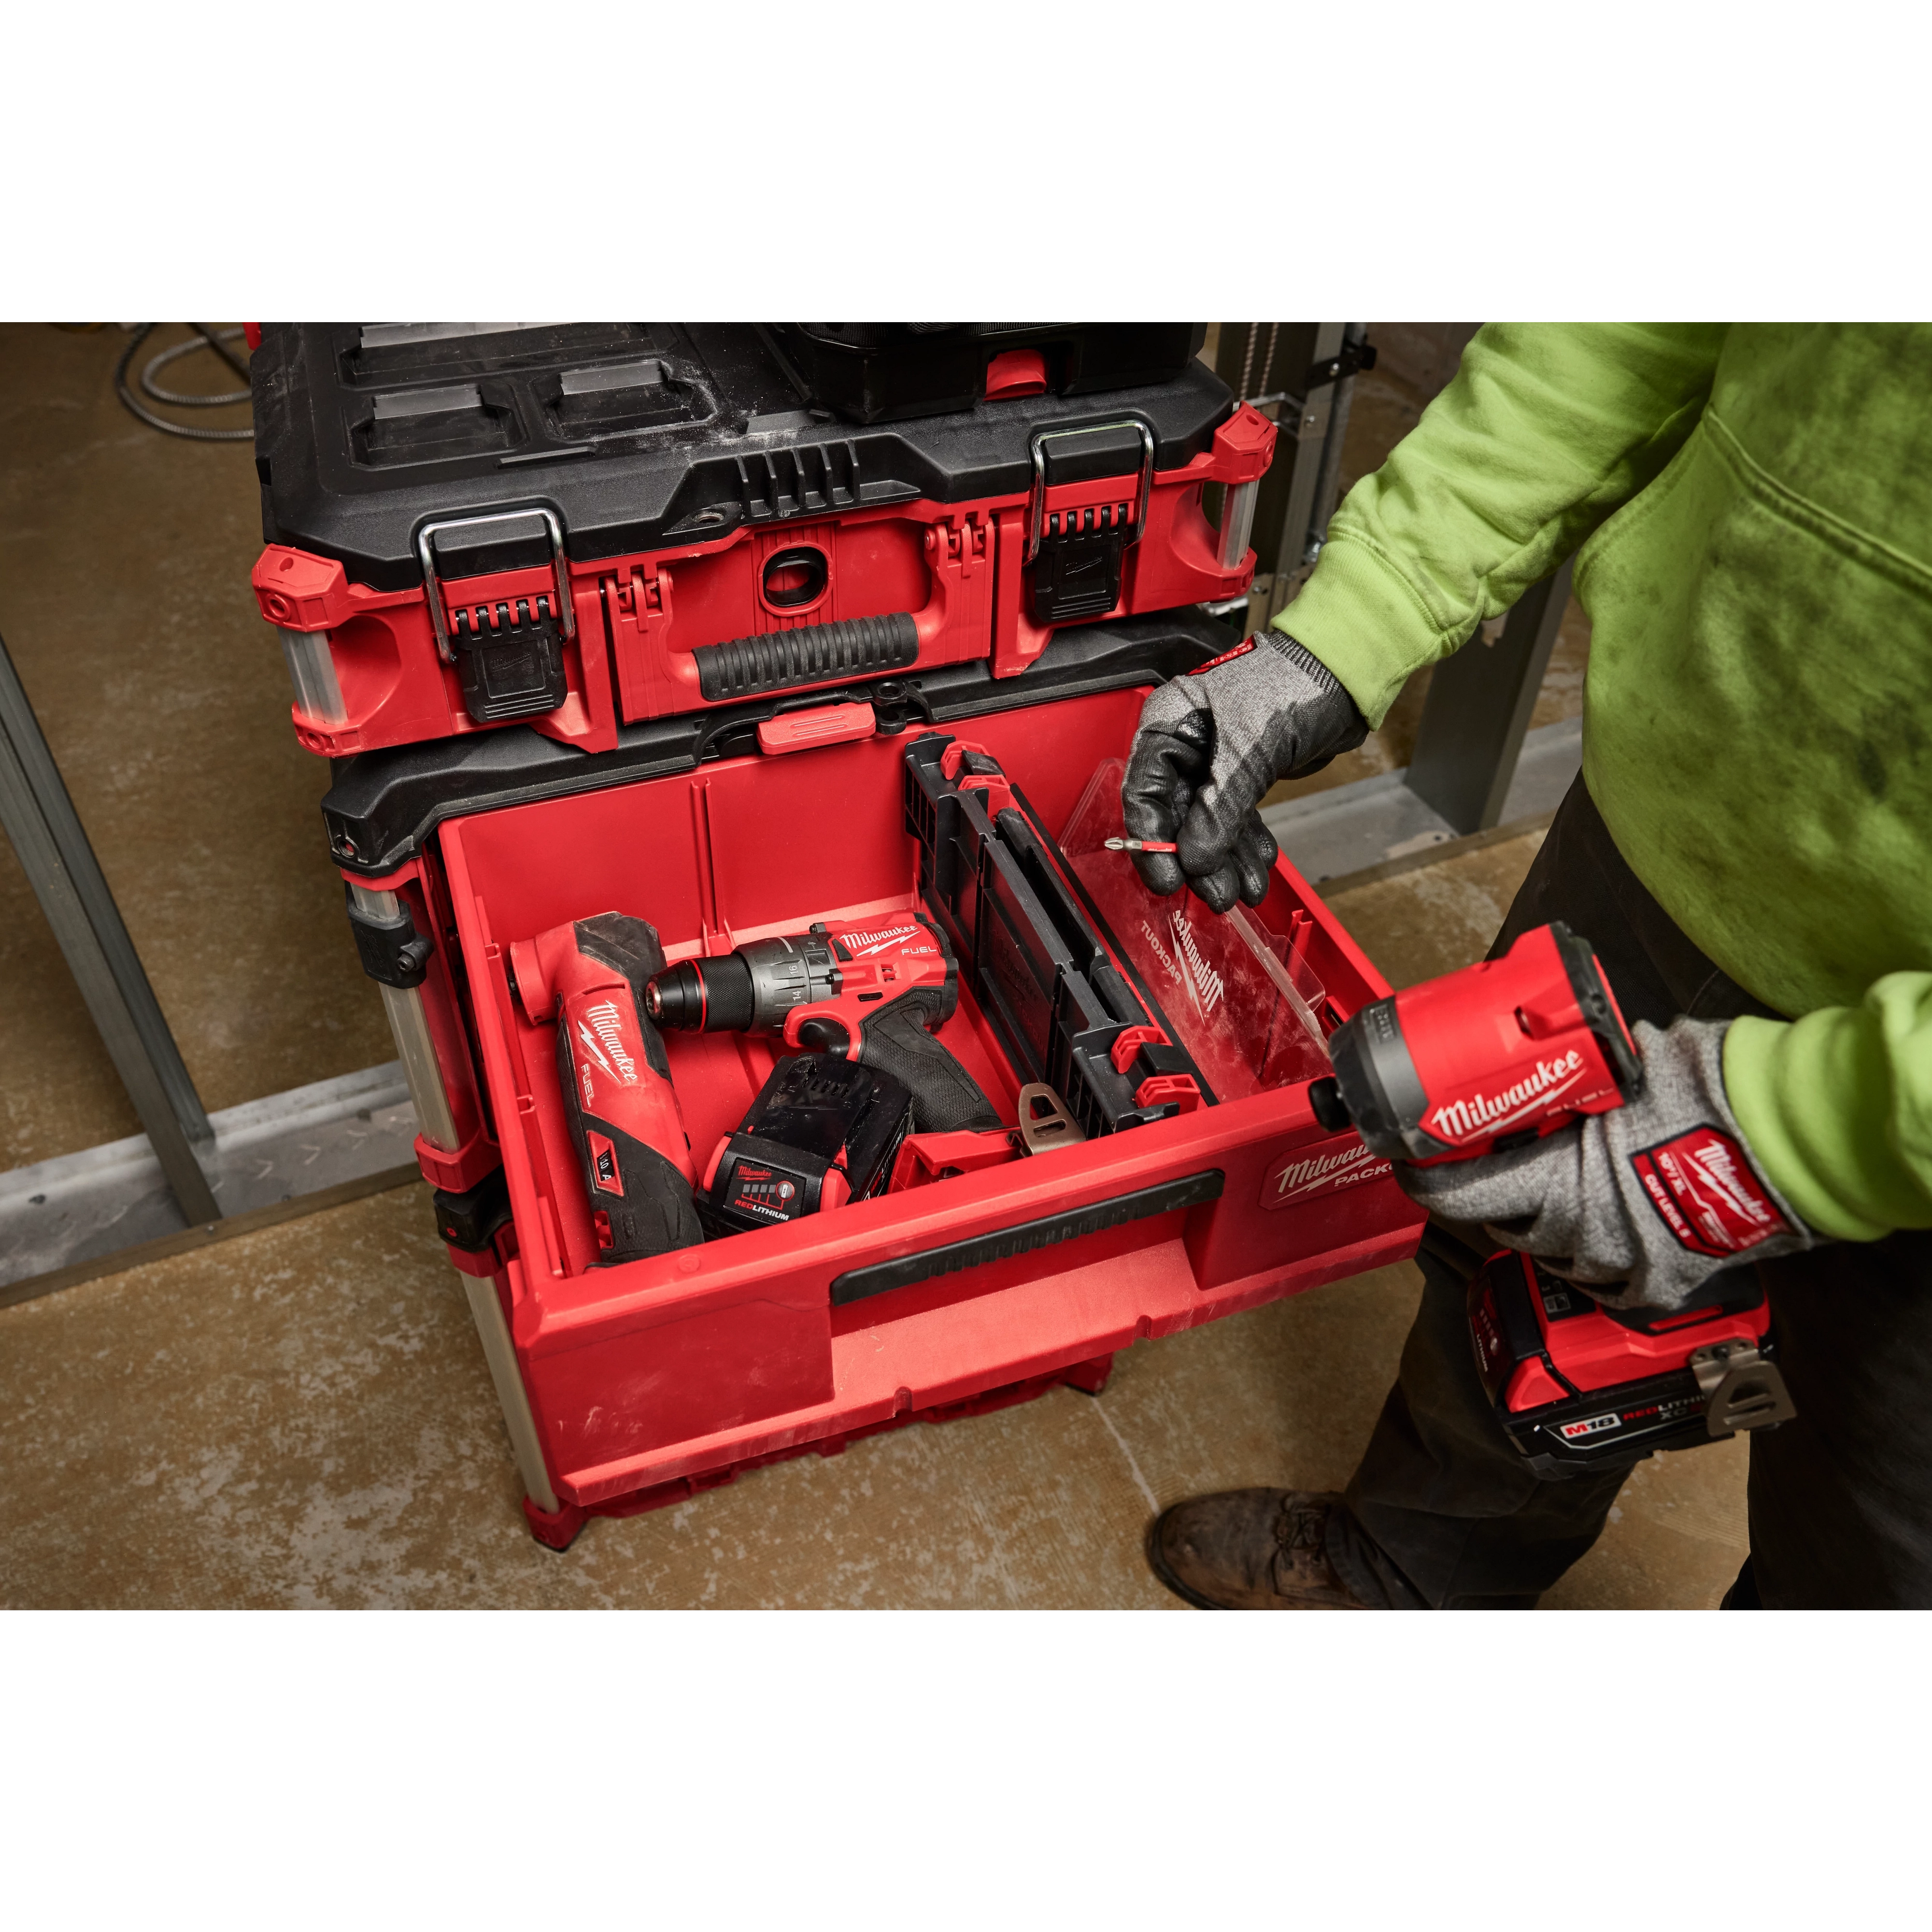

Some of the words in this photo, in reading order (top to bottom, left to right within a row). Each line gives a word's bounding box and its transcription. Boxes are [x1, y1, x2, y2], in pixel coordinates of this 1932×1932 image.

[839, 925, 918, 949] Milwaukee
[901, 946, 937, 955] FUEL
[789, 966, 798, 975] 16
[793, 991, 801, 1001] 14
[586, 1000, 638, 1082] Milwaukee
[581, 1063, 594, 1107] FUEL
[1431, 1050, 1584, 1136] Milwaukee
[600, 1159, 609, 1169] 10
[738, 1165, 772, 1177] Milwaukee
[1274, 1144, 1370, 1193] Milwau
[1645, 1174, 1666, 1198] CUT
[1694, 1139, 1771, 1222] Milwaukee
[735, 1199, 790, 1221] REDLITHIUM
[1565, 1417, 1615, 1435] M18
